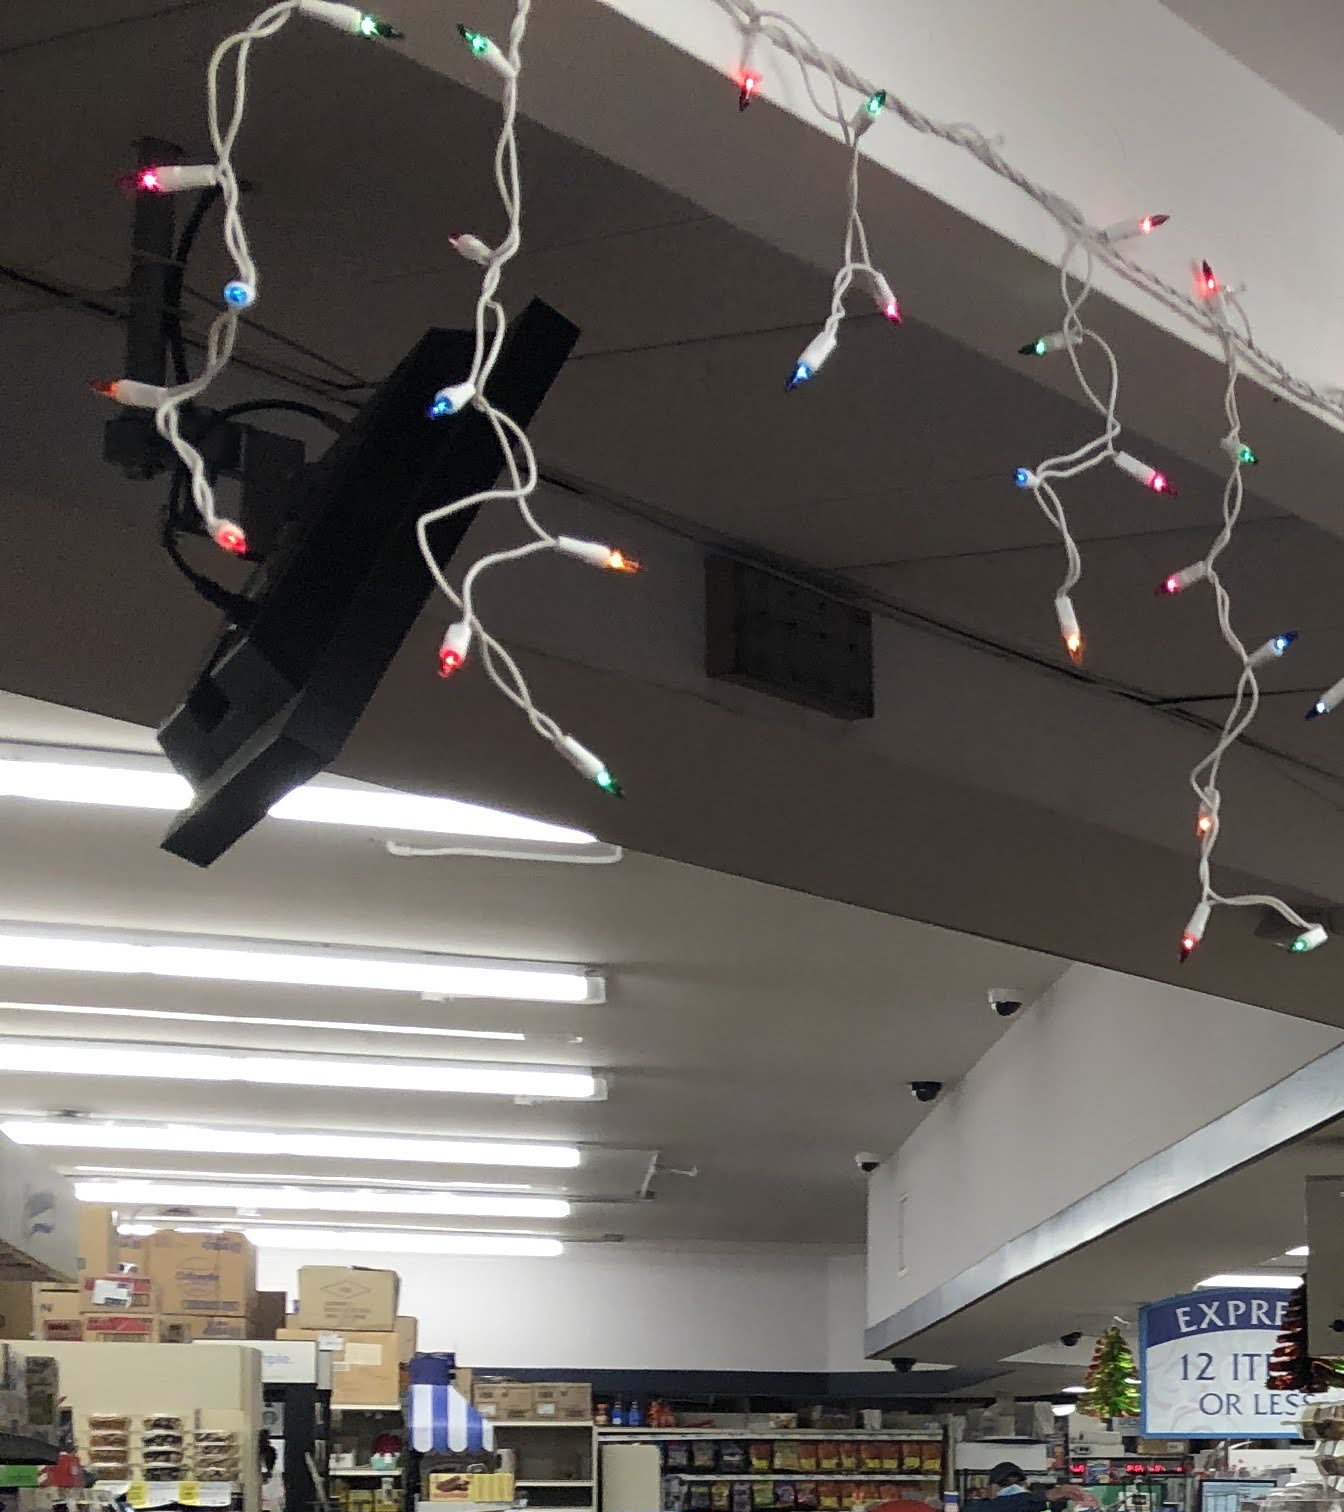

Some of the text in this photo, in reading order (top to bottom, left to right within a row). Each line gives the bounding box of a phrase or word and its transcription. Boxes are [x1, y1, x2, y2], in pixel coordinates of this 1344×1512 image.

[1175, 1299, 1289, 1333] EXPRE
[1181, 1352, 1216, 1381] 12
[1199, 1393, 1315, 1416] OR LESS
